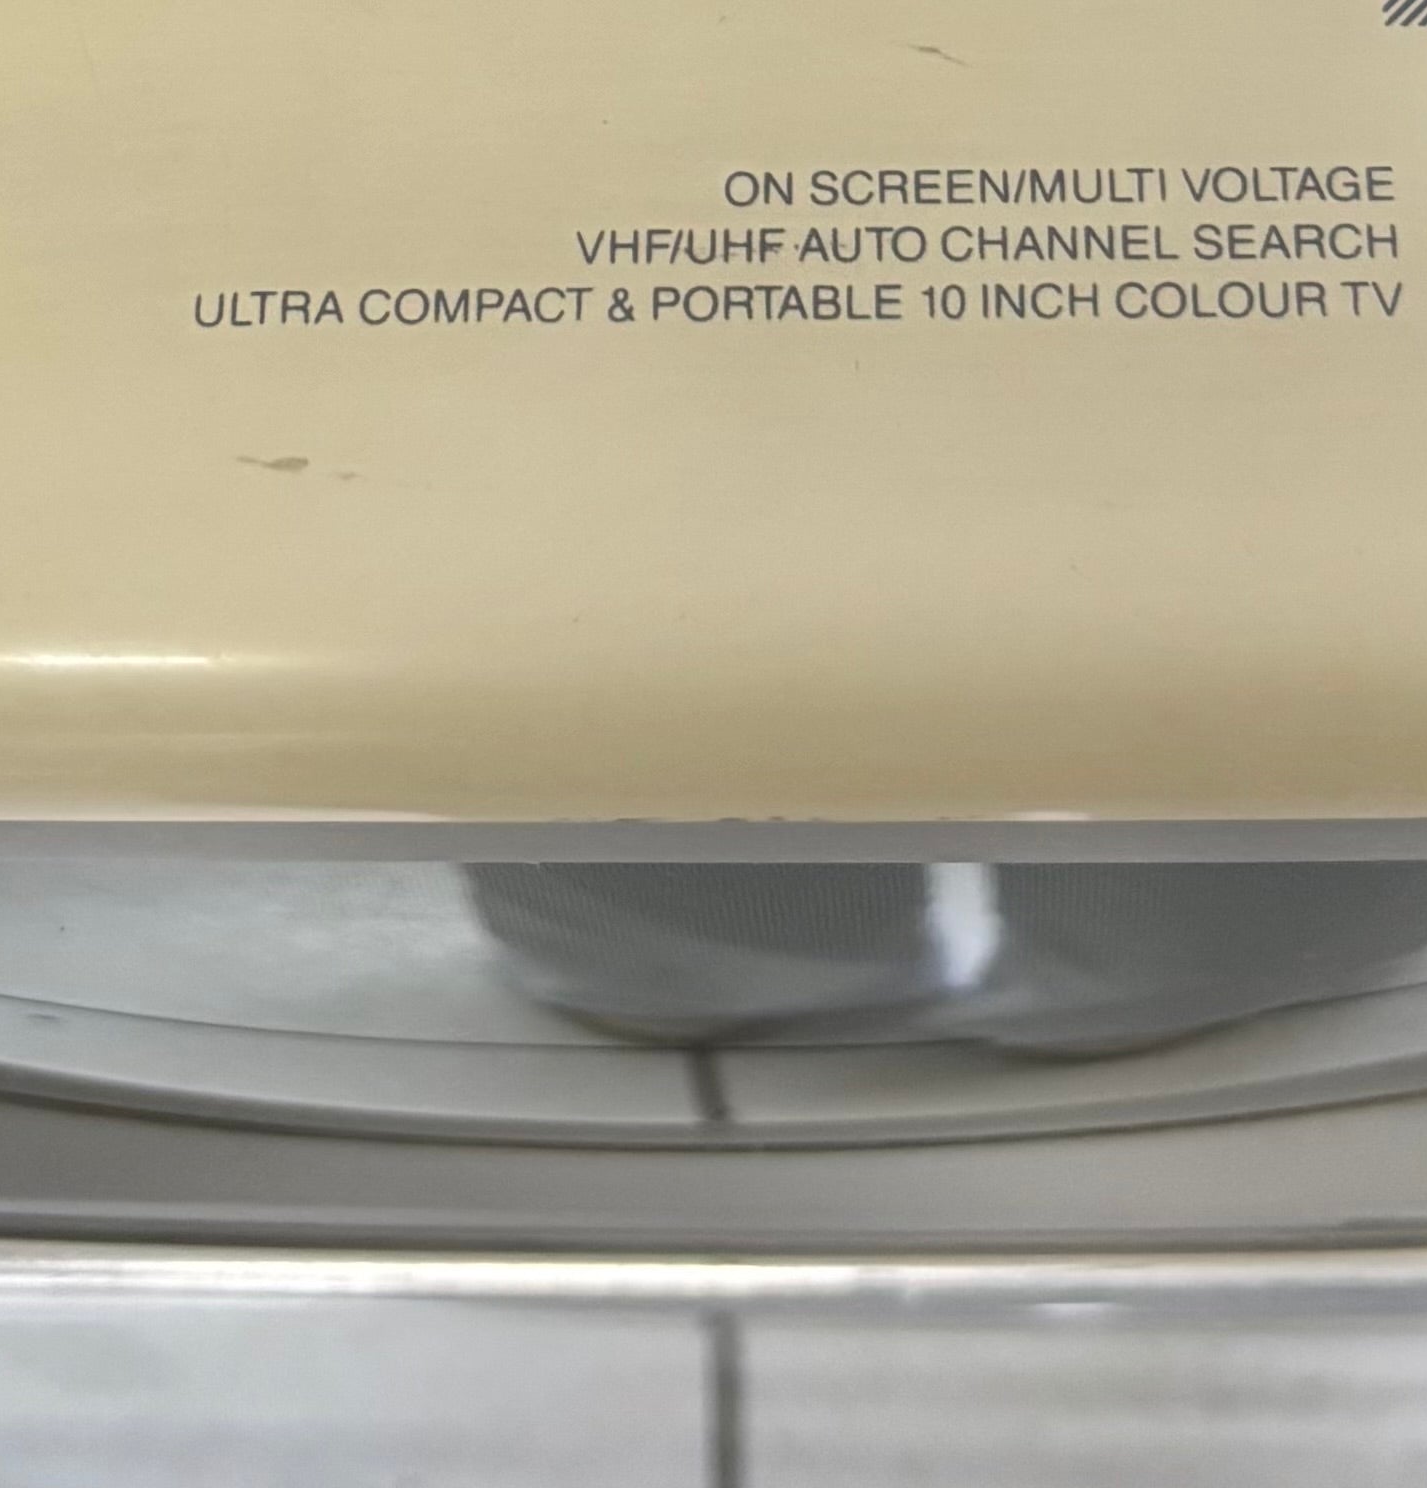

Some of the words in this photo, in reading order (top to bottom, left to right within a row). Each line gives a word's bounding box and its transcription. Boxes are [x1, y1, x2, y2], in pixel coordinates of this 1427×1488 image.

[724, 170, 794, 208] ON
[810, 167, 1167, 206] SCREEN/MULTI
[1181, 166, 1395, 202] VOLTAGE
[576, 227, 786, 265] VHF/UHF
[798, 227, 927, 262] AUTO
[940, 224, 1179, 261] CHANNEL
[1193, 223, 1399, 260] SEARCH
[194, 289, 344, 327] ULTRA
[358, 286, 594, 325] COMPACT
[607, 286, 636, 323] &
[652, 284, 903, 323] PORTABLE
[920, 283, 967, 320] 10
[981, 282, 1099, 320] INCH
[1114, 280, 1327, 319] COLOUR
[1340, 280, 1403, 318] TV
